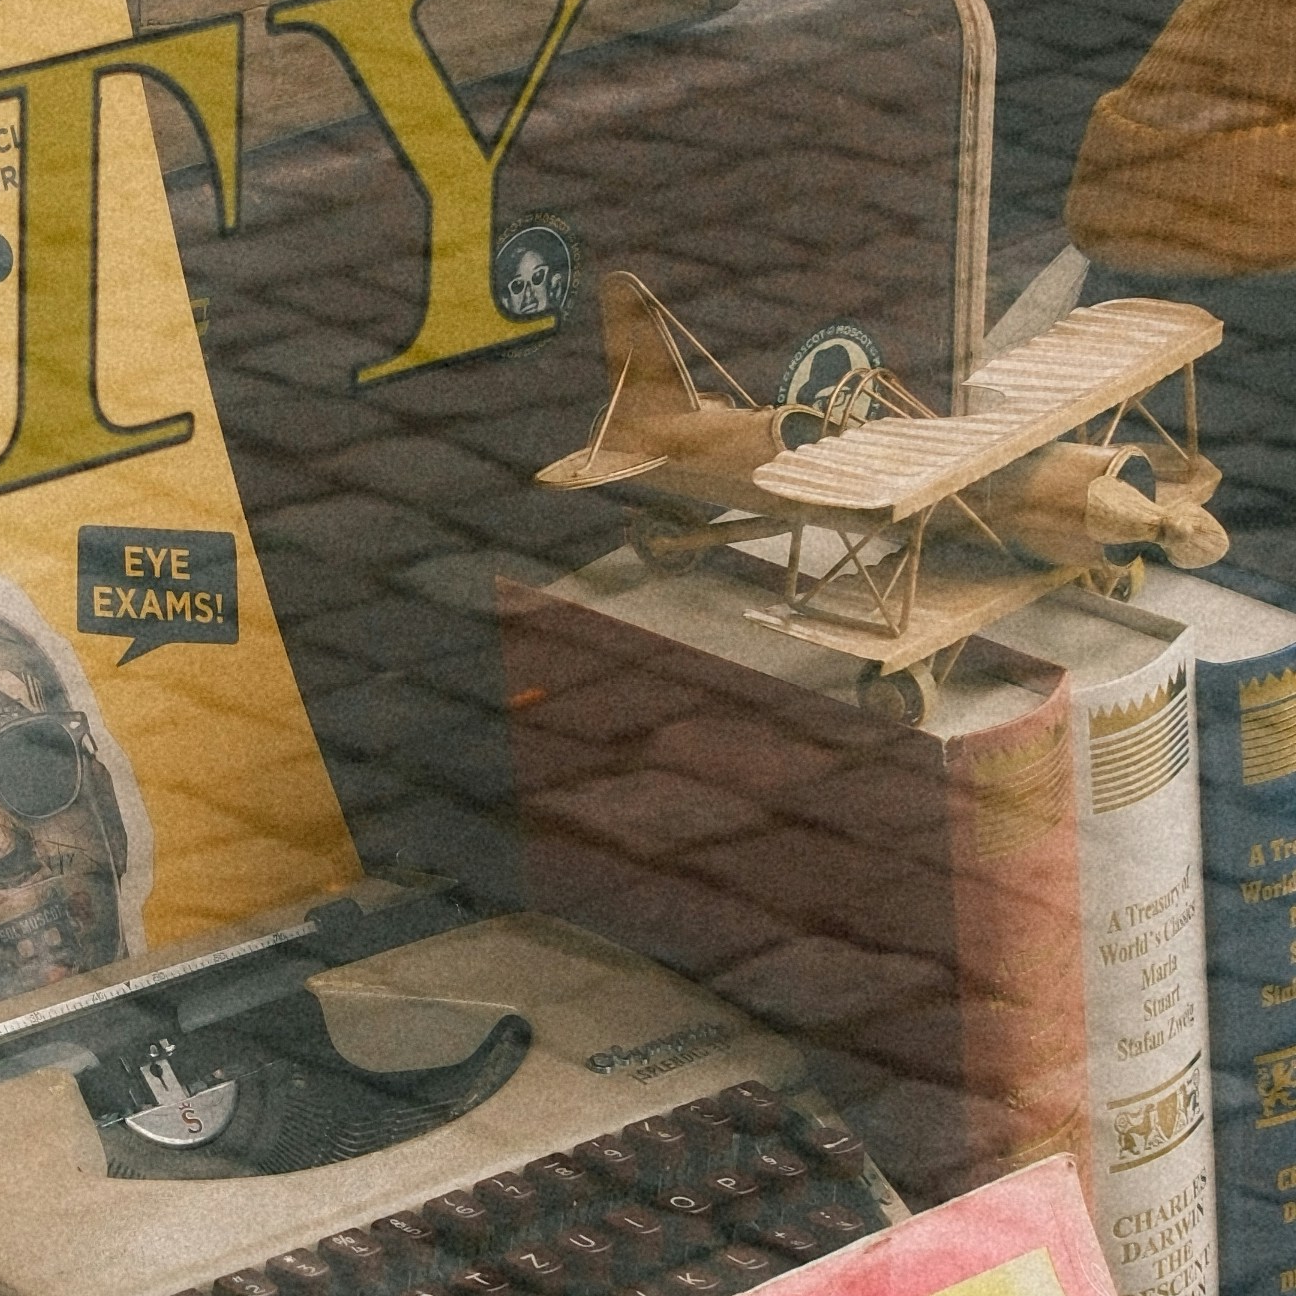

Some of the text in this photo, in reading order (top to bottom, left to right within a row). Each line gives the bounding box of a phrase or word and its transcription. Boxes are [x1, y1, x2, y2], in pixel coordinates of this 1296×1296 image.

[788, 325, 872, 371] MOSCOT MOSCOT
[123, 545, 191, 580] EYE
[92, 586, 226, 623] EXAMS!
[1248, 843, 1266, 867] A
[1107, 910, 1122, 934] A
[1125, 881, 1182, 928] Treasury
[1099, 930, 1162, 966] World's
[1142, 983, 1181, 1022] Stuart
[1112, 1167, 1207, 1238] CHARLES
[464, 1271, 492, 1287] T
[569, 1233, 597, 1250] U
[716, 1177, 737, 1191] P
[1120, 1202, 1204, 1265] DARWIN
[676, 1271, 707, 1288] K
[1153, 1239, 1193, 1280] THE
